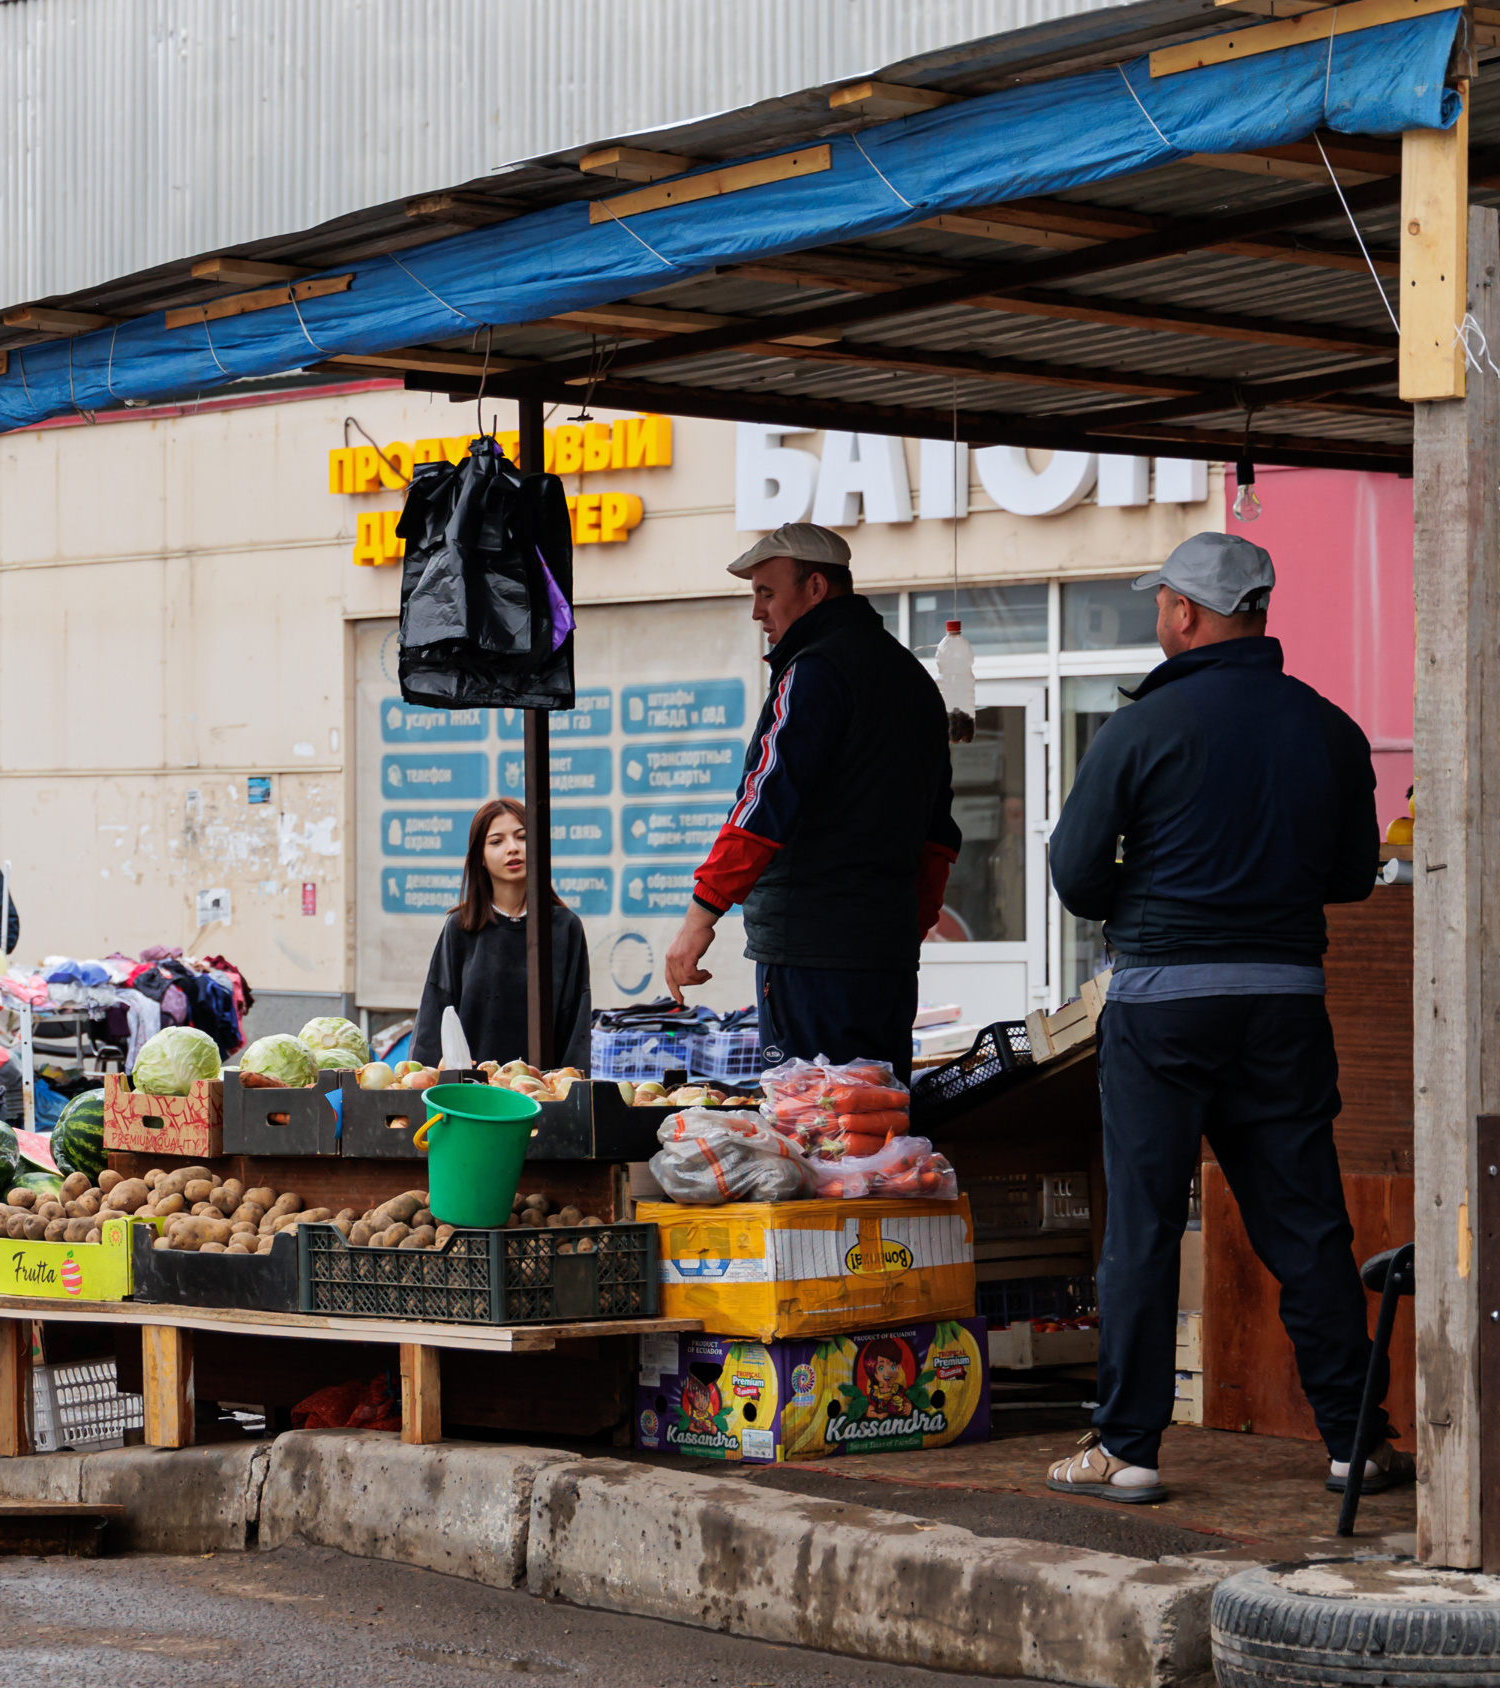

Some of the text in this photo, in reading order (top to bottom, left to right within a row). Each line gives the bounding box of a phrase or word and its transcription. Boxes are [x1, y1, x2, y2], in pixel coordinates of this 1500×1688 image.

[648, 689, 695, 708] штрафы
[405, 709, 481, 730] услуги ЖКХ
[572, 715, 591, 730] газ
[648, 709, 688, 728] ГИБДД
[647, 749, 732, 770] транспортные
[405, 766, 452, 785] телефон
[405, 816, 453, 834] домофон
[569, 825, 603, 840] связь
[404, 835, 442, 852] охрана
[405, 874, 462, 891] денежные
[405, 891, 459, 909] переводы
[111, 1131, 200, 1151] PREMIUM QUALITY
[12, 1251, 58, 1284] Frutta
[691, 1340, 719, 1349] PRODUCT
[854, 1330, 917, 1342] PRODUCT OF ECUADOR
[696, 1347, 723, 1356] ECUADOR
[937, 1350, 967, 1359] TROPICAL
[933, 1356, 970, 1368] Premium
[732, 1375, 765, 1387] Premium
[736, 1370, 761, 1379] TROPICAL
[826, 1409, 946, 1442] Kassandra
[667, 1424, 739, 1450] Kassandra
